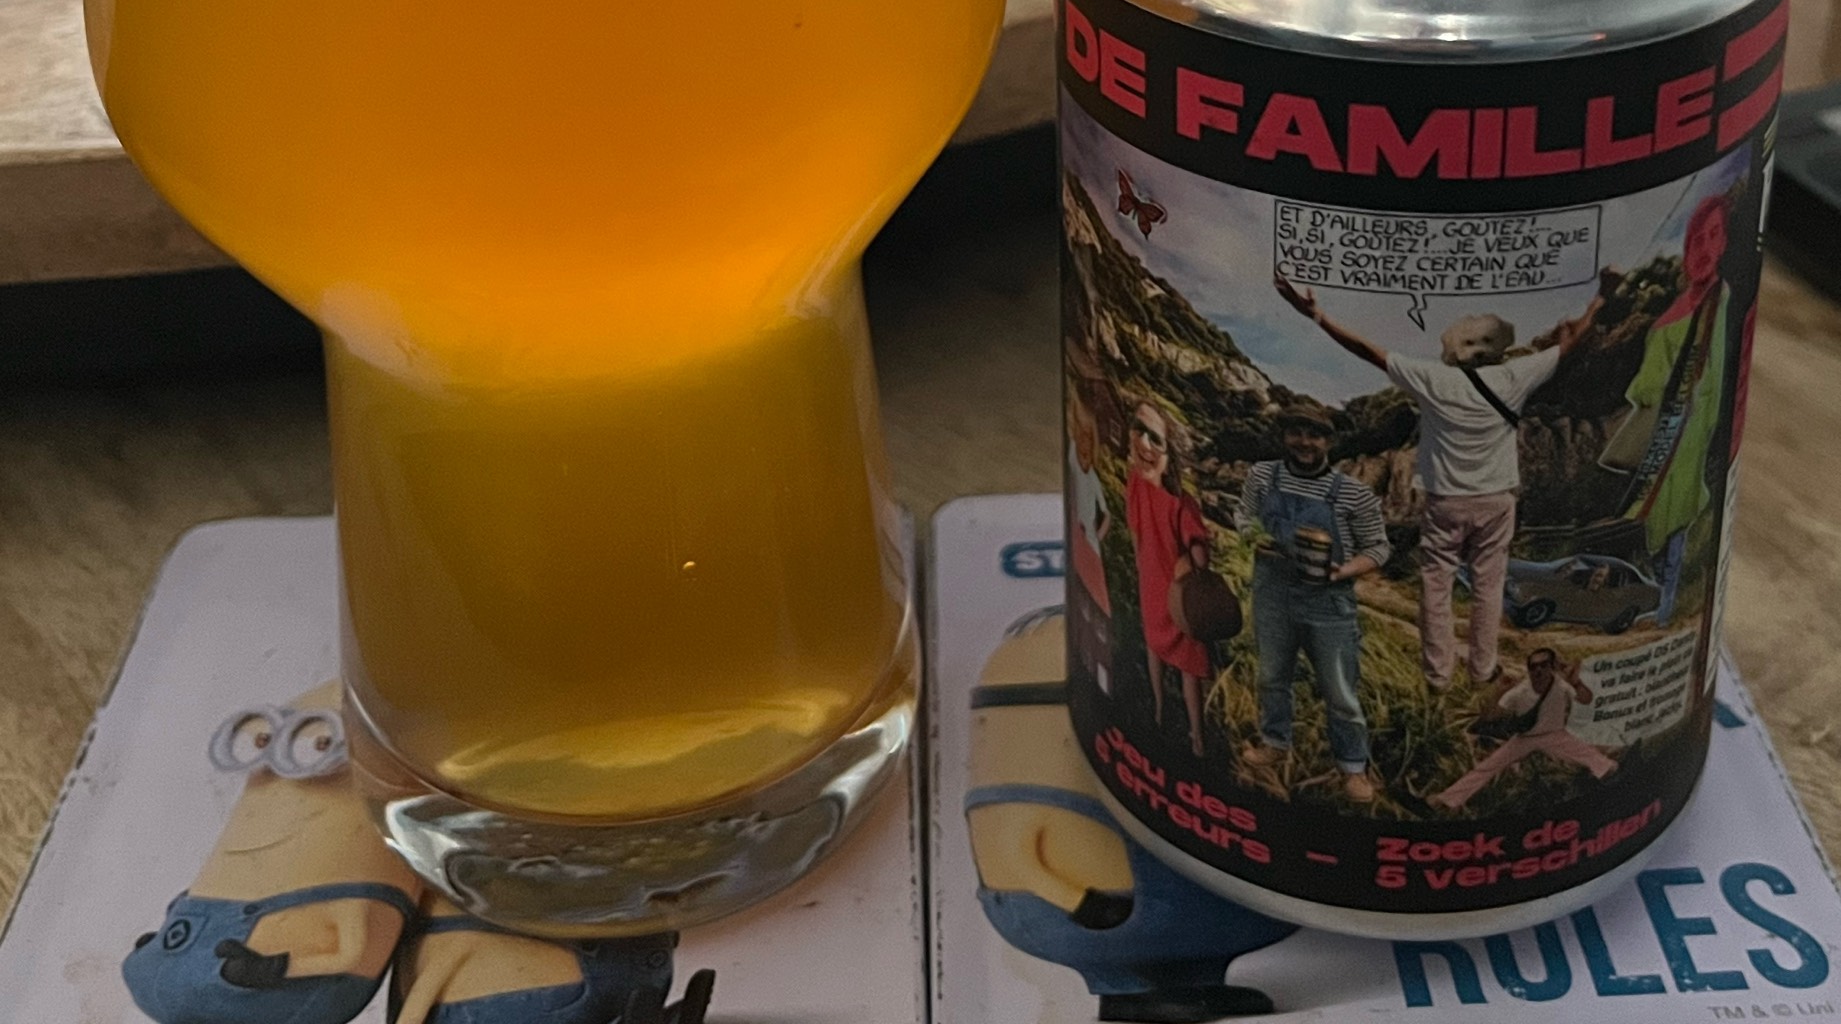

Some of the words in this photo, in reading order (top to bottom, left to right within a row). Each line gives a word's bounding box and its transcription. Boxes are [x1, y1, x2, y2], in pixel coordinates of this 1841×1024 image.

[1176, 63, 1717, 179] FAMILLE
[1280, 206, 1303, 223] ET
[1279, 242, 1332, 264] VOUS
[1341, 251, 1409, 271] SOYEZ
[1416, 255, 1506, 272] CERTAIN
[1515, 249, 1560, 269] QUE
[1449, 238, 1475, 254] JE
[1484, 234, 1539, 253] VEUX
[1548, 227, 1590, 248] QUE
[1277, 260, 1333, 282] C'EST
[1340, 269, 1449, 291] VRAIMENT
[1454, 274, 1483, 290] DE
[1105, 726, 1166, 789] Jeu
[1176, 780, 1258, 832] des
[1116, 761, 1272, 865] erreurs
[1376, 831, 1505, 862] Zoek
[1523, 819, 1580, 850] de
[1424, 798, 1662, 890] verschillen
